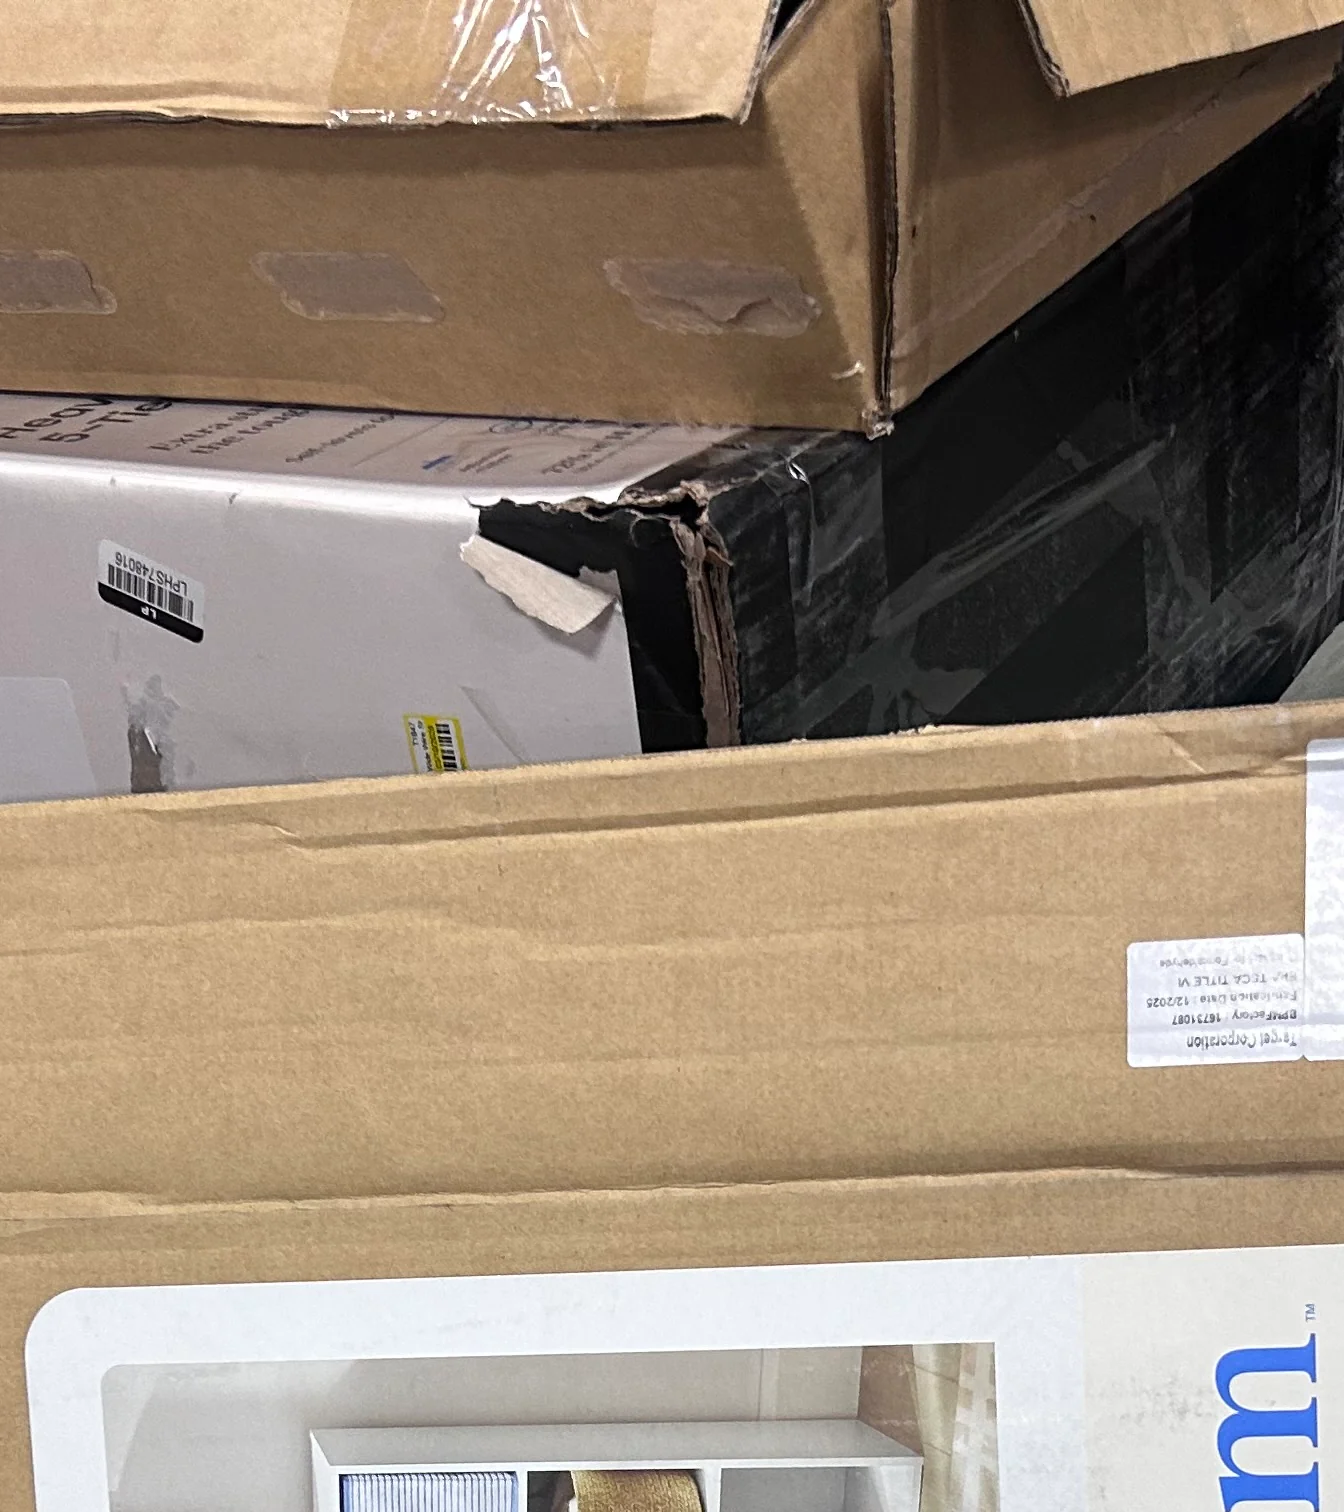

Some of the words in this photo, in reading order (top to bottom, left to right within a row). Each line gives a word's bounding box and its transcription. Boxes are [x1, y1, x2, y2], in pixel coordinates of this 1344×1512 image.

[114, 551, 188, 597] LPHS748016
[140, 606, 157, 620] LP
[1186, 1030, 1256, 1051] Corporation
